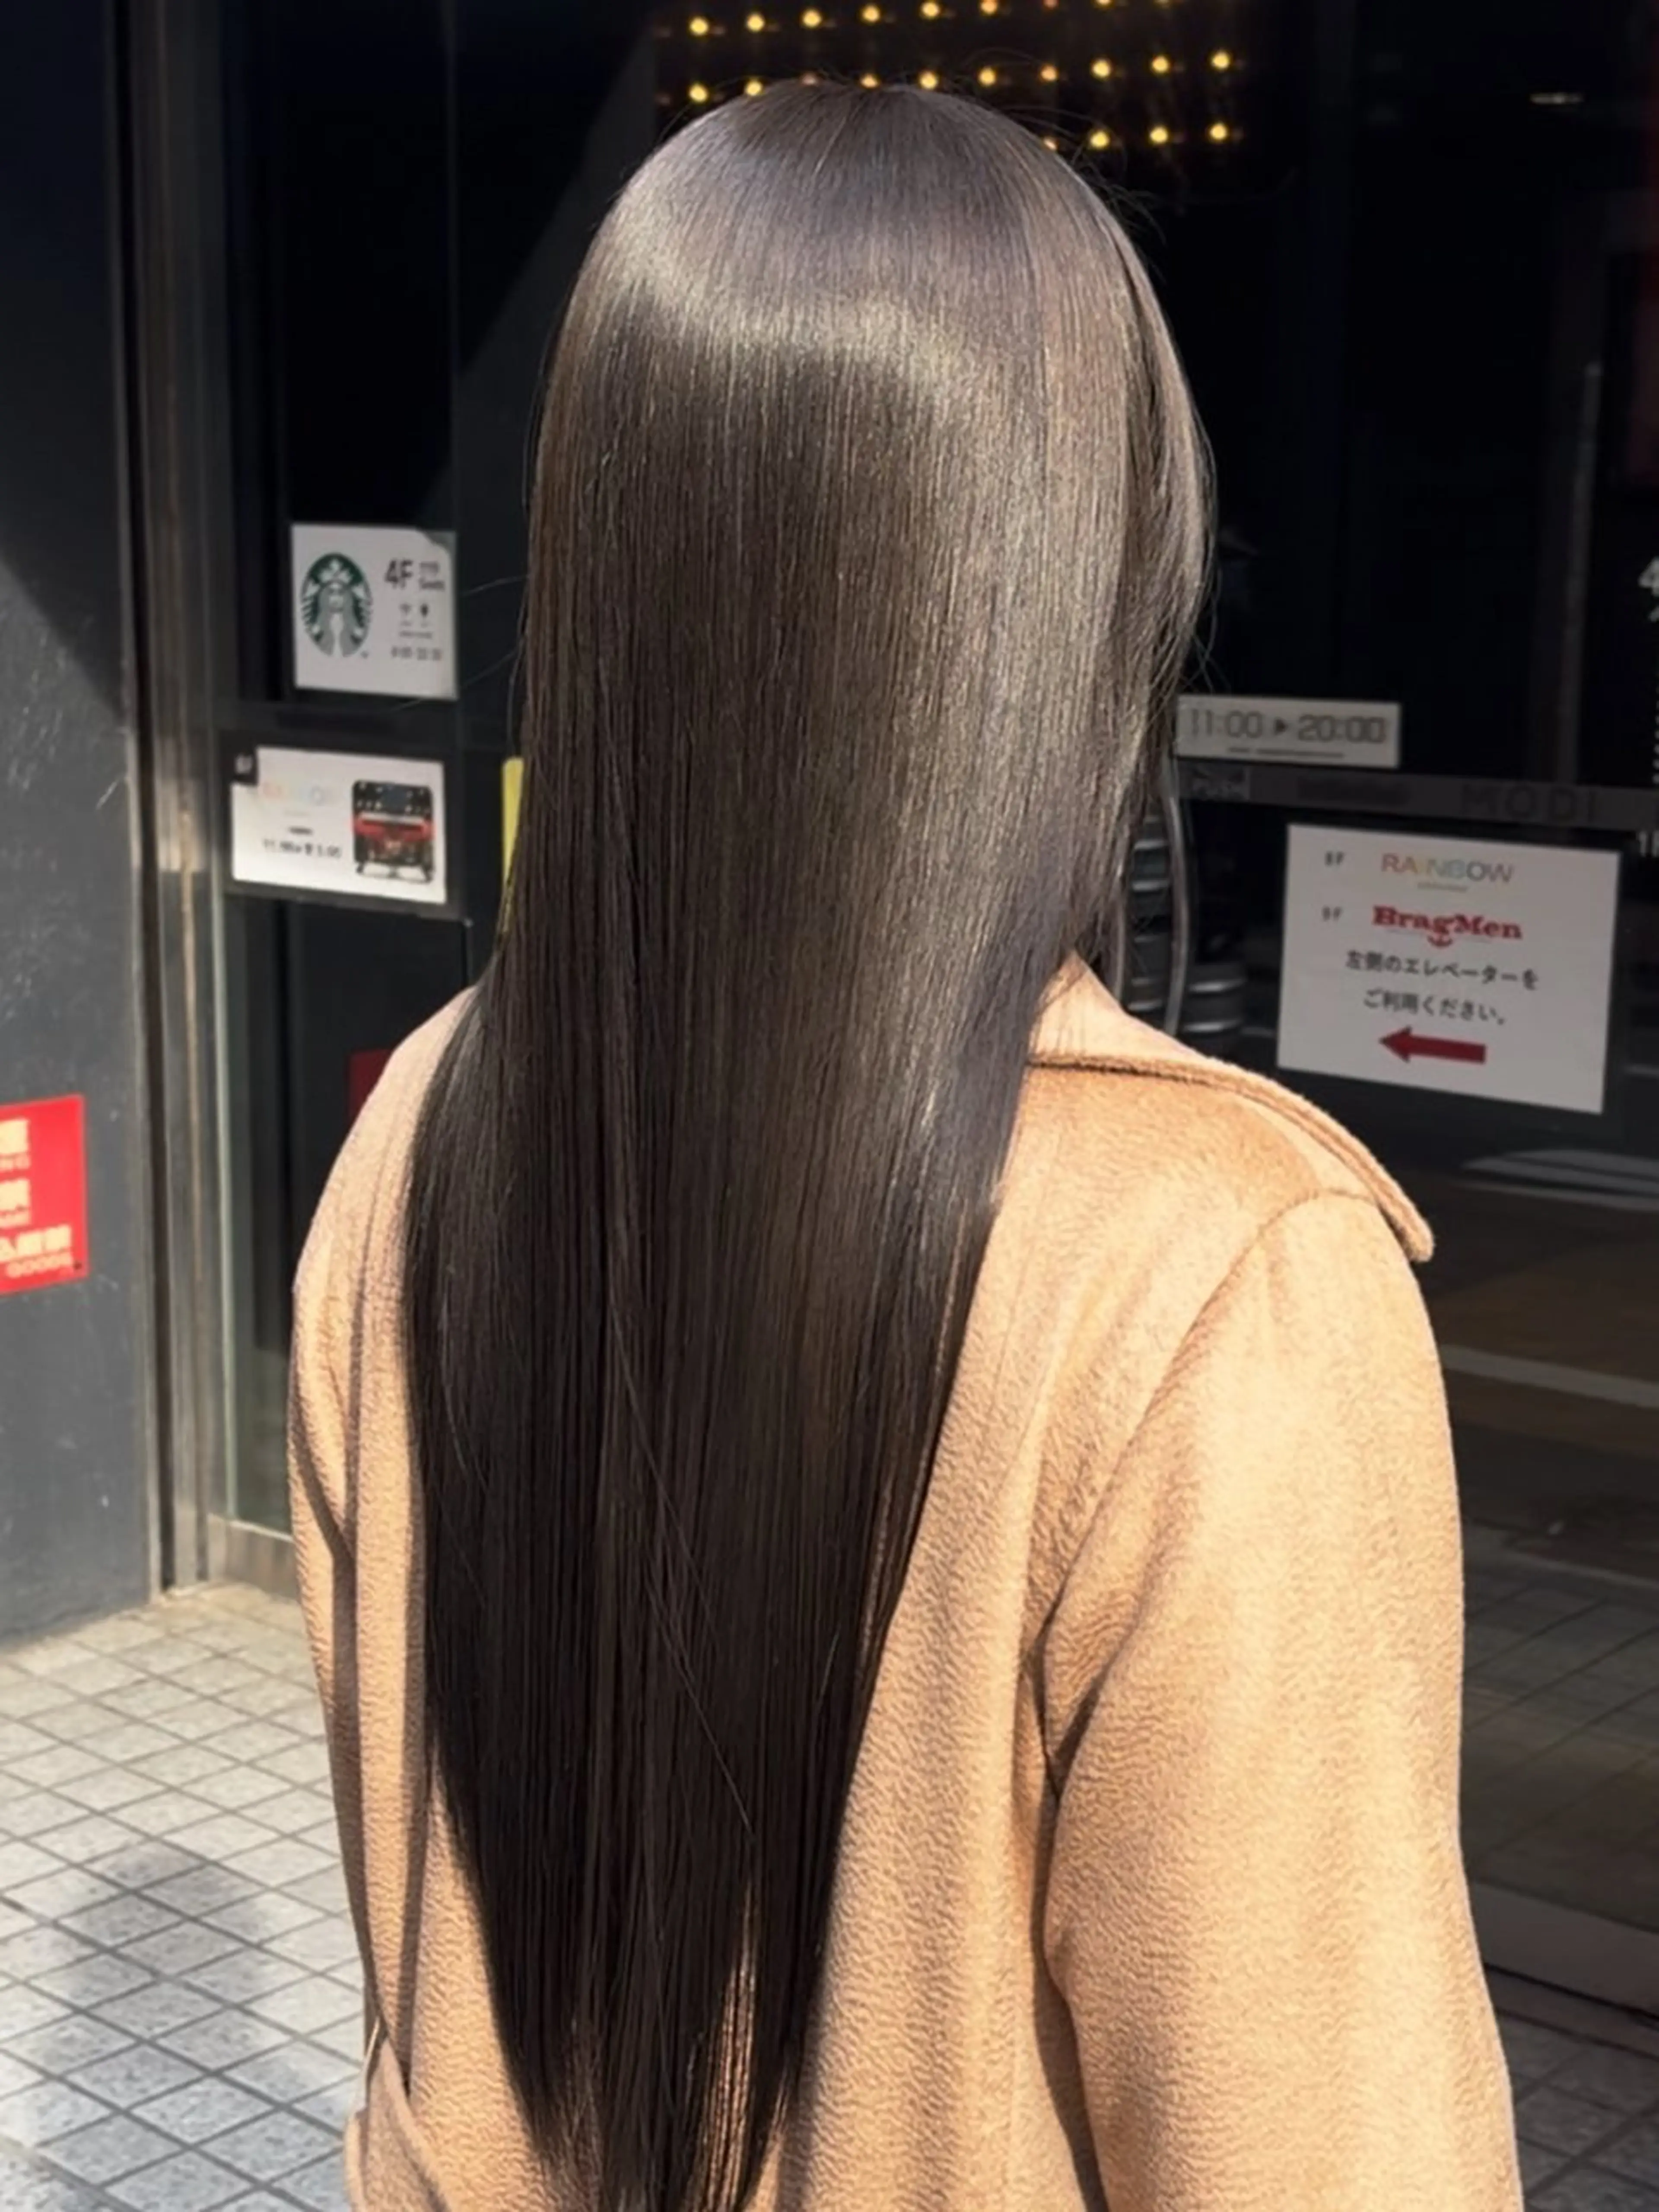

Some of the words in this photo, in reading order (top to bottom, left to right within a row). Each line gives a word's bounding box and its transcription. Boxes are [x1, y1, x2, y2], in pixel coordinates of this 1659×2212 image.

[384, 559, 413, 590] 4F
[1190, 708, 1262, 739] 11:00
[1297, 713, 1387, 744] 20:00
[1459, 784, 1597, 824] MODI
[1381, 852, 1515, 883] RAINBOW
[1372, 904, 1523, 940] BragMen
[1345, 950, 1539, 991] 左側のエレベーターを
[1363, 988, 1505, 1026] ご利用ください。
